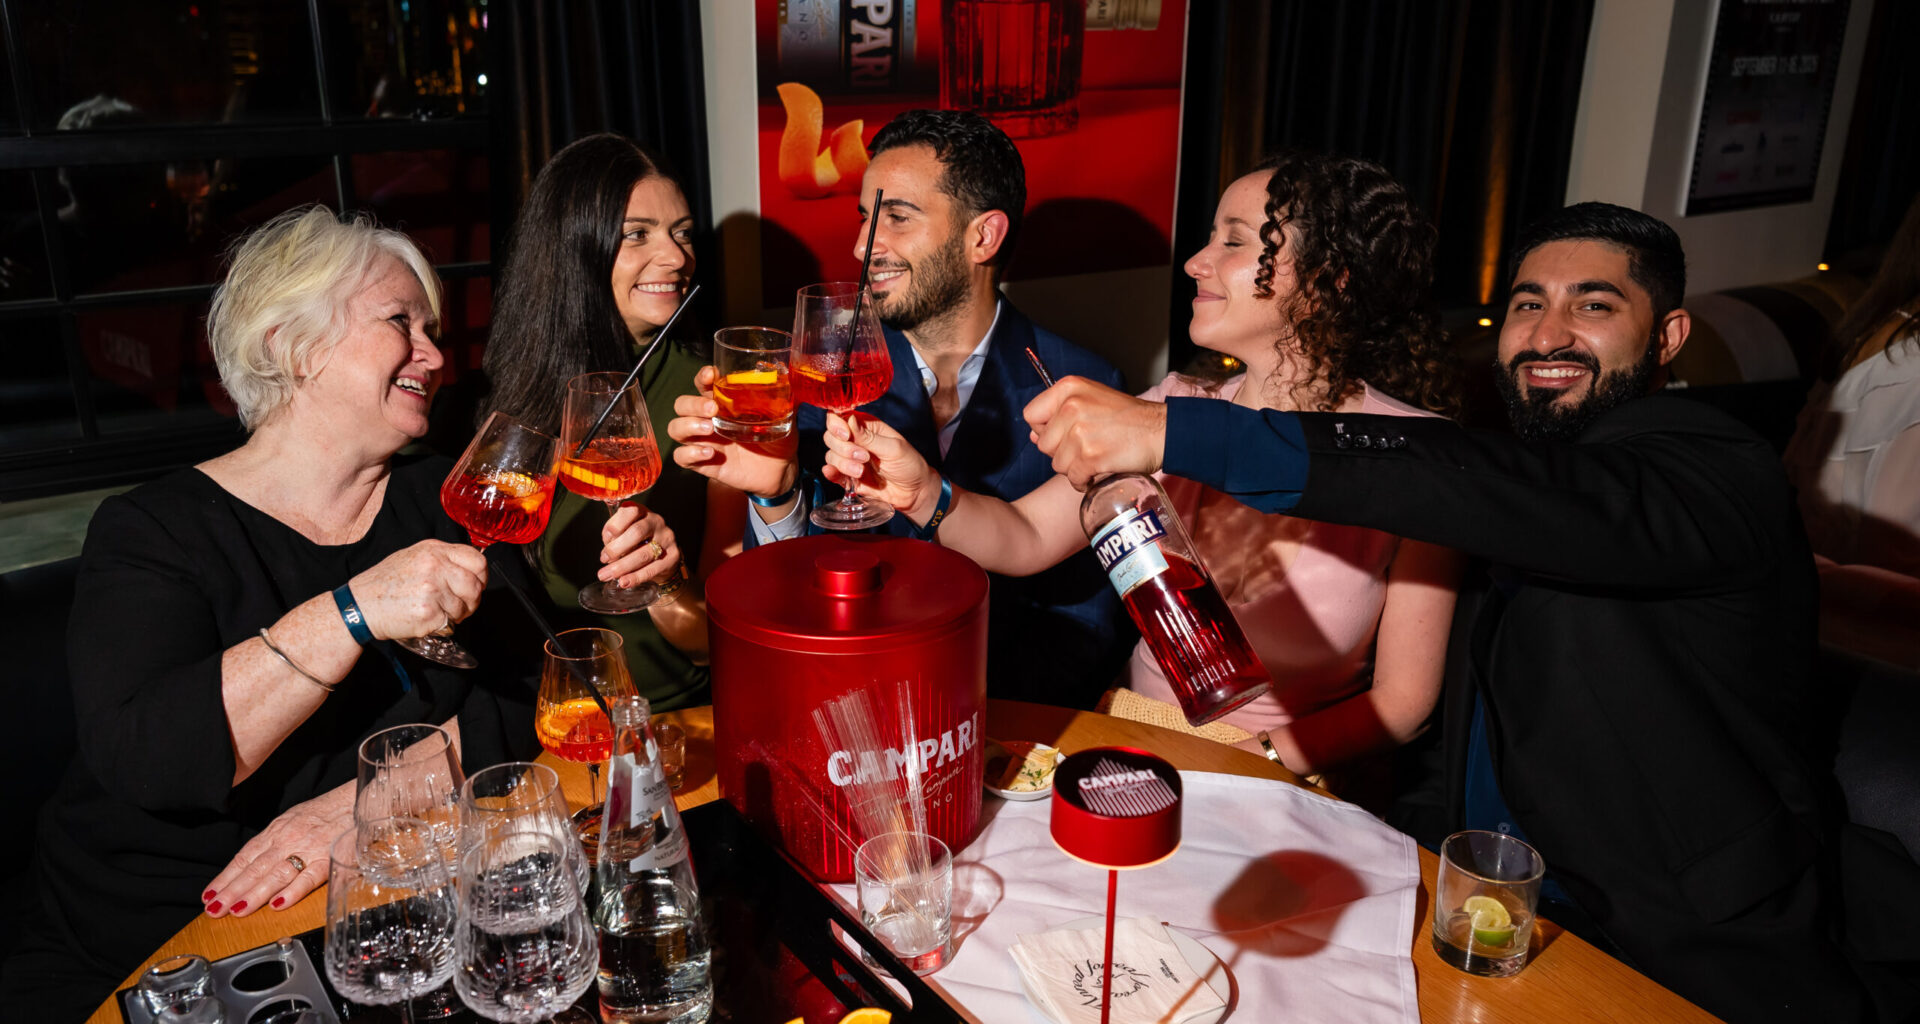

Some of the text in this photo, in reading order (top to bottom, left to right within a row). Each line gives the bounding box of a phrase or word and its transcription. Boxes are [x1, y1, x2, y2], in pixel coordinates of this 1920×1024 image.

[931, 509, 944, 527] VIP
[344, 602, 361, 624] VIP
[827, 711, 978, 787] CAMPARI
[1078, 768, 1157, 790] CAMPARI
